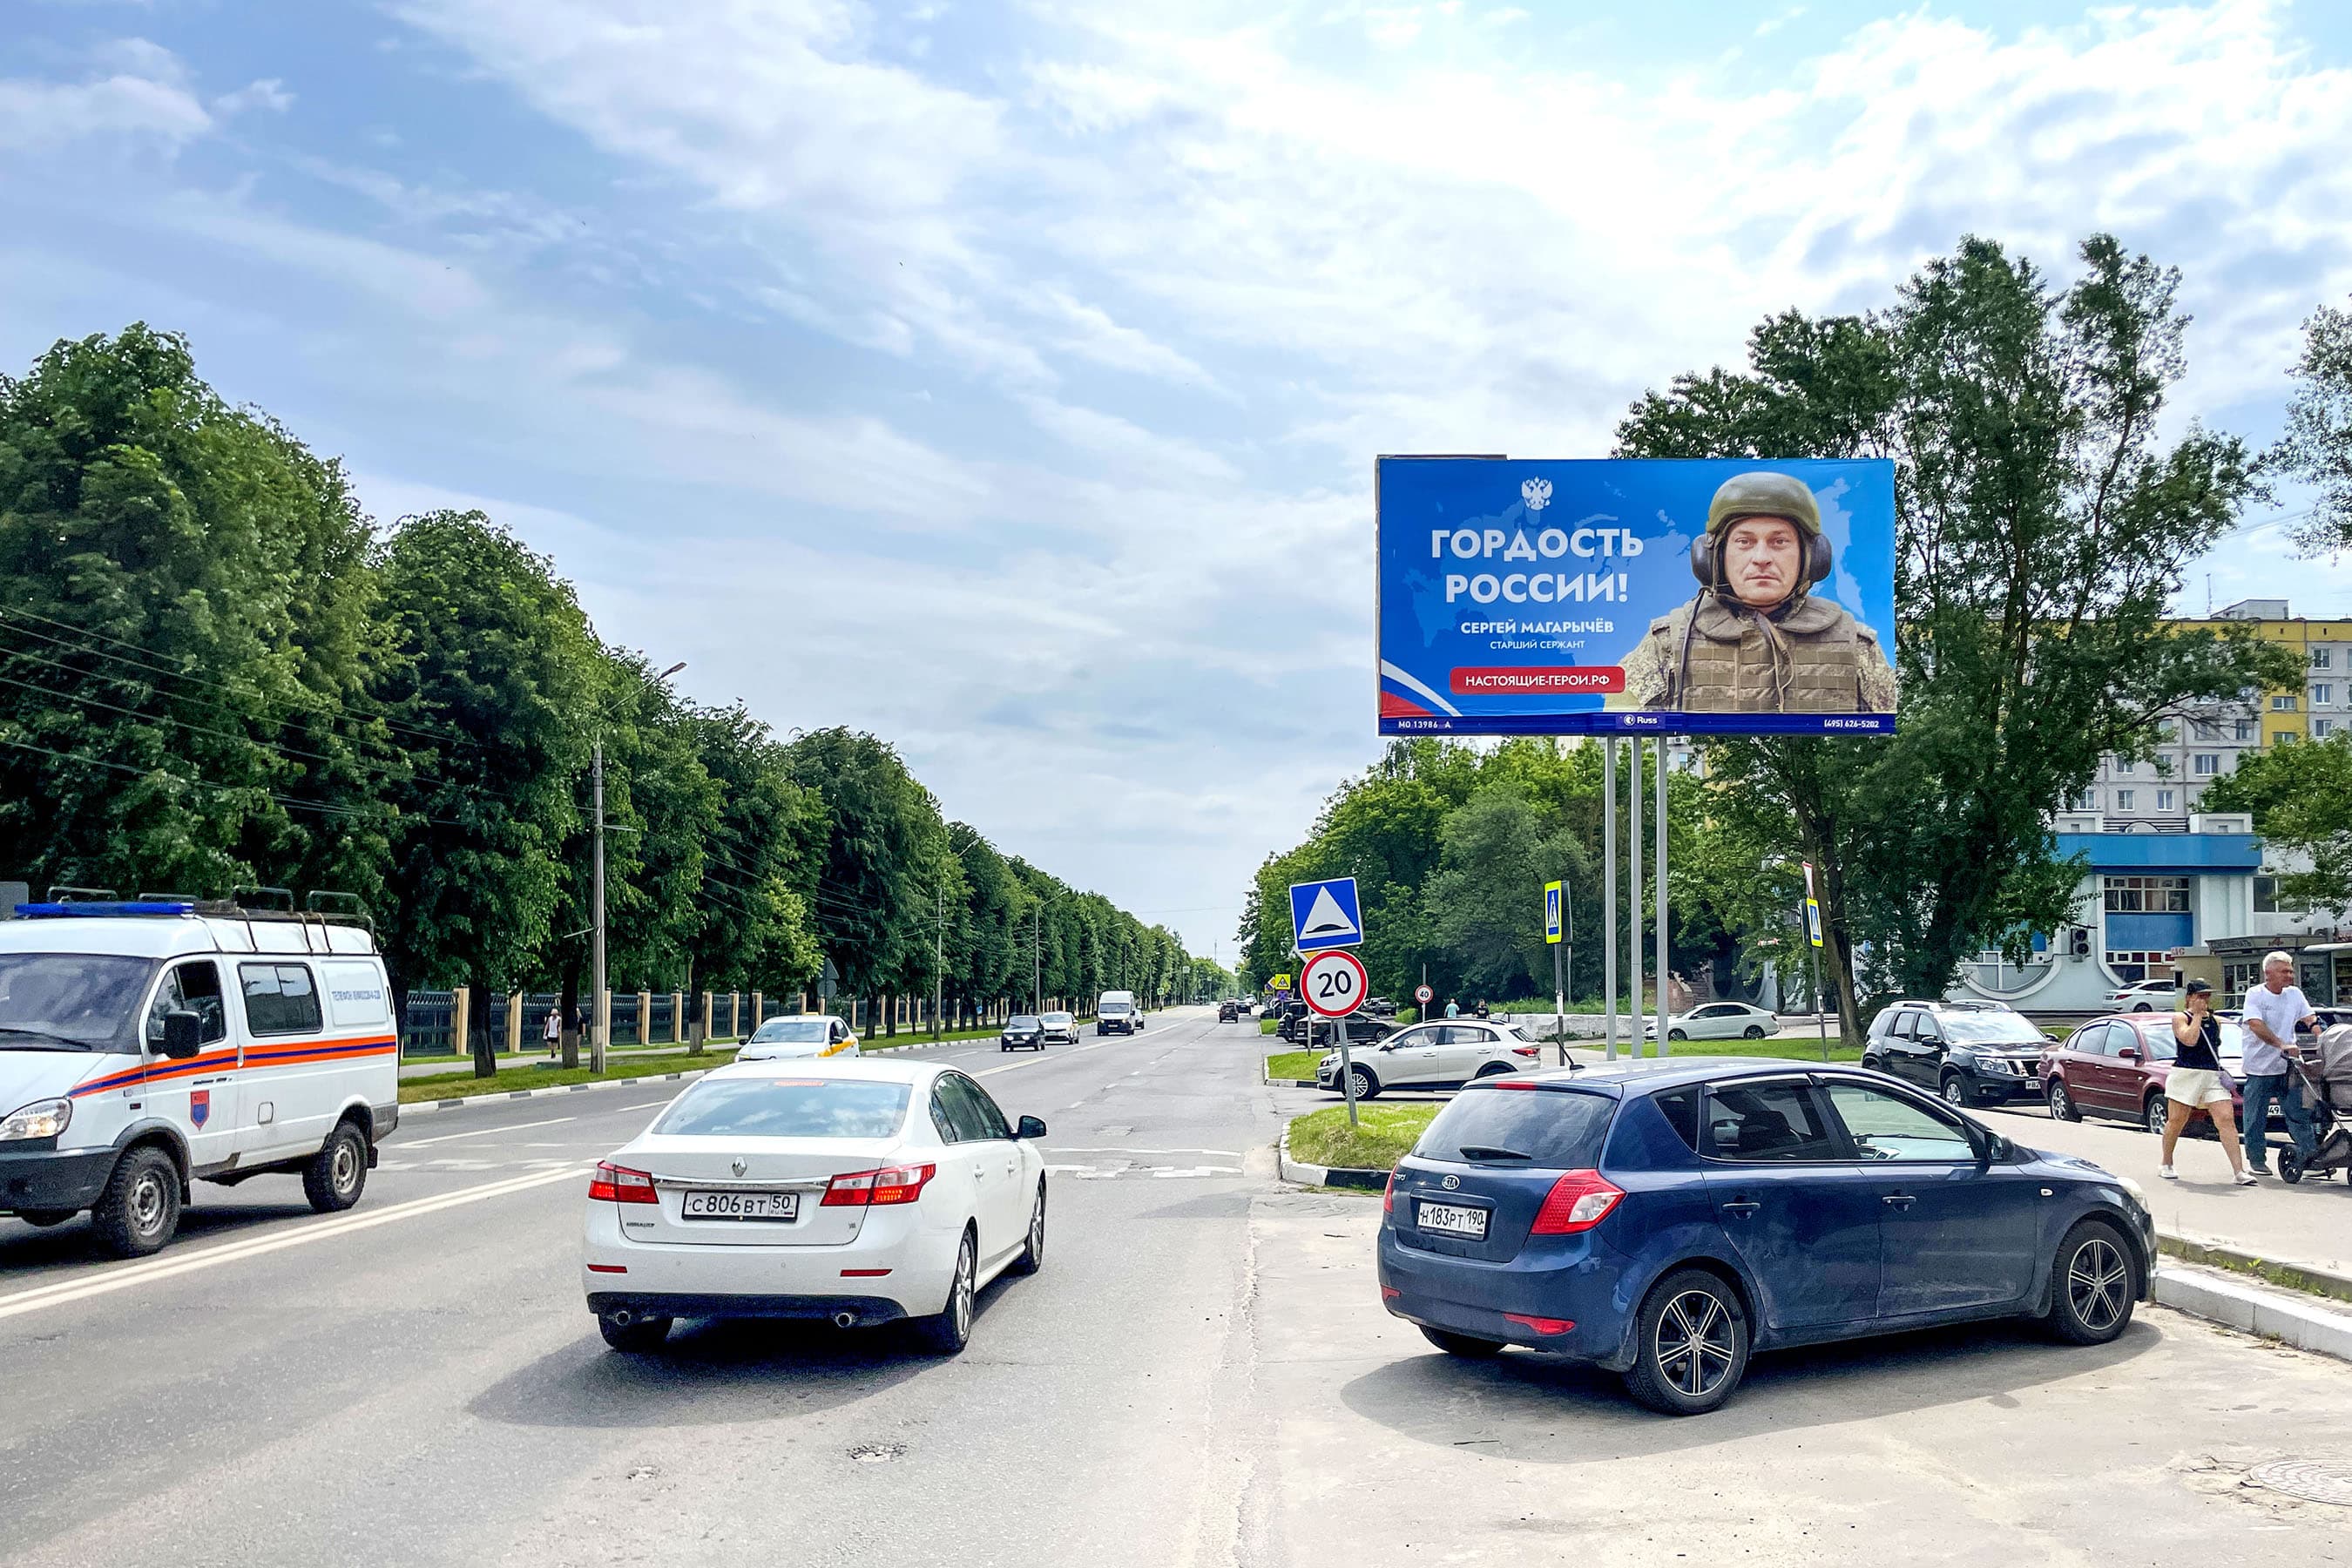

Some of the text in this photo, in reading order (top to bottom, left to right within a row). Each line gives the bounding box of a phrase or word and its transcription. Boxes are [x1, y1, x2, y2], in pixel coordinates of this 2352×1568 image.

[1431, 528, 1644, 562] ГОРДОСТЬ
[1445, 572, 1628, 604] РОССИИ!
[1460, 618, 1614, 634] СЕРГЕЙ МАГАРЫЧЁВ
[1490, 639, 1585, 650] СТАРШИЙ СЕРЖАНТ
[1465, 675, 1610, 687] НАСТОЯЩИЕ-ГЕРОИ.РФ
[1317, 970, 1352, 998] 20
[1419, 990, 1429, 999] 40
[771, 1195, 790, 1209] 50
[1467, 1210, 1484, 1226] 190
